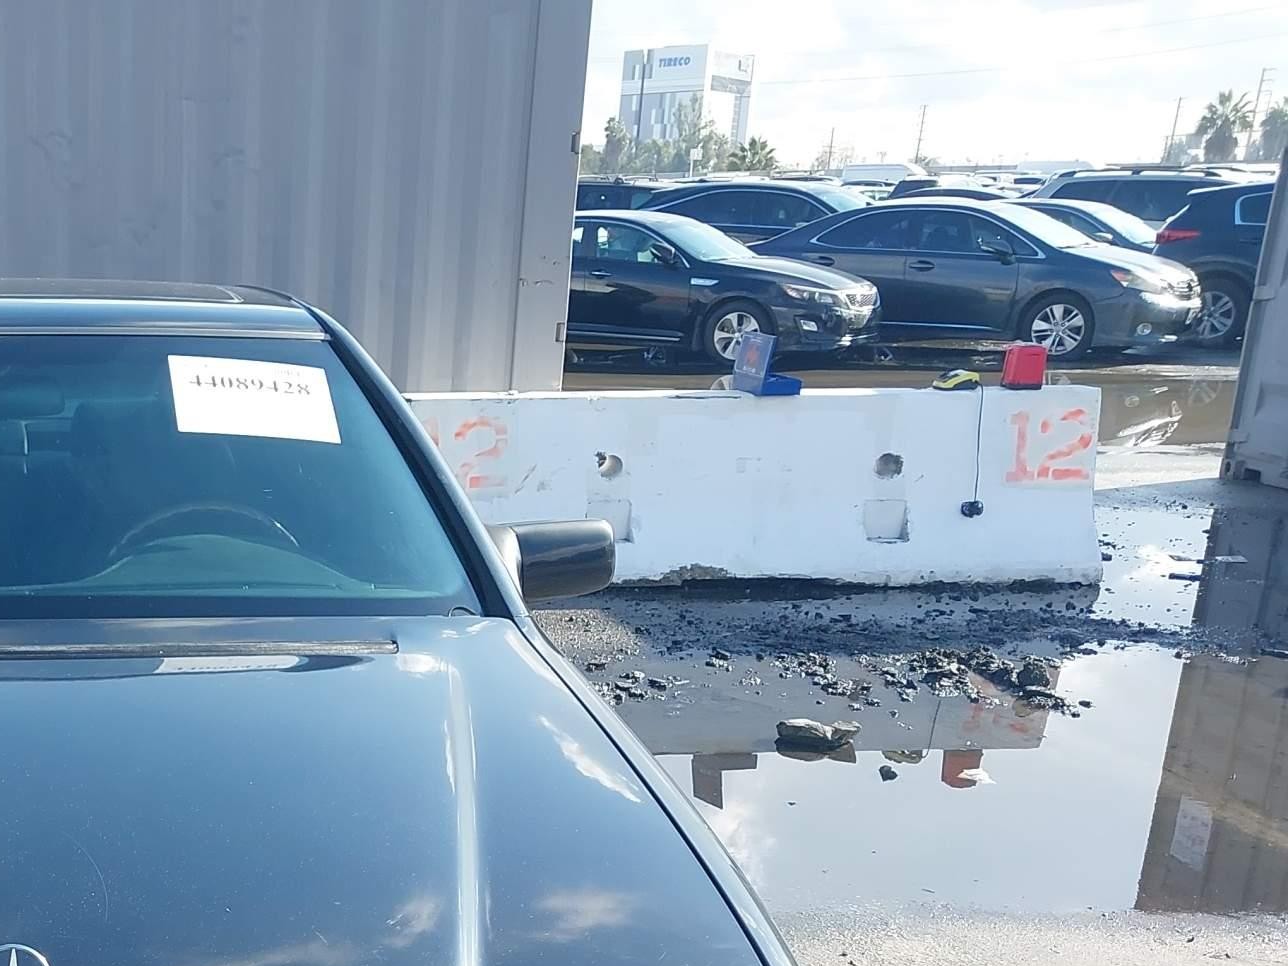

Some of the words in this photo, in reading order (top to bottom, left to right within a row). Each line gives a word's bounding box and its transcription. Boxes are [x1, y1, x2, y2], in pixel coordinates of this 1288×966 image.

[658, 56, 691, 69] TIRECO
[188, 373, 312, 396] 44089428
[1005, 408, 1093, 482] 12
